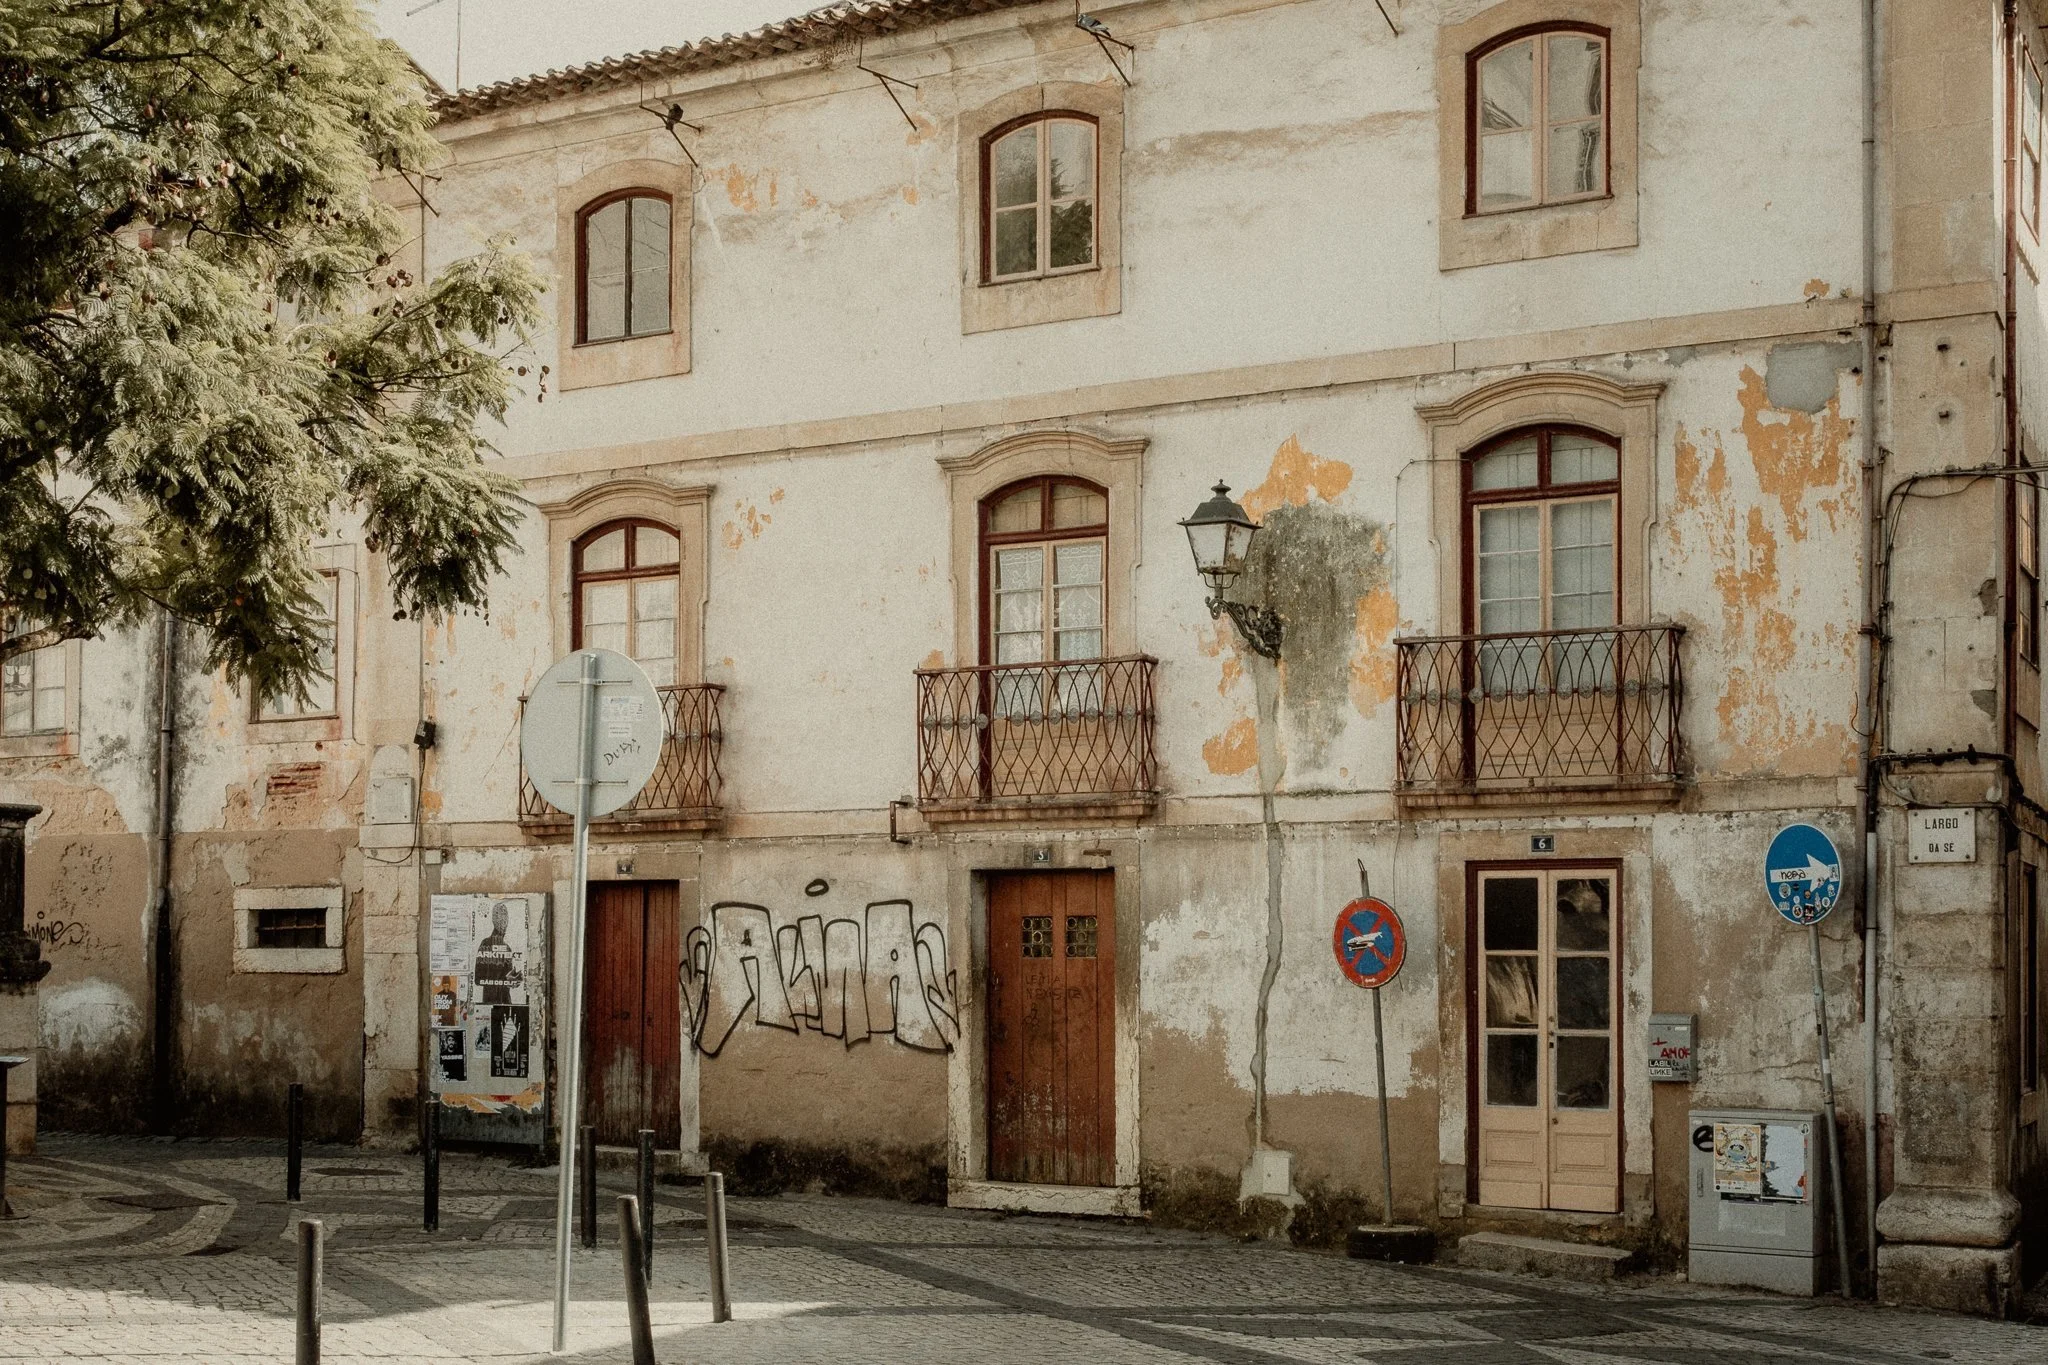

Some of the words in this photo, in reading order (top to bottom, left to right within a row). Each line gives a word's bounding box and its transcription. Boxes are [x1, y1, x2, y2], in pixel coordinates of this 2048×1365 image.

[1924, 817, 1959, 830] LARGO
[1538, 838, 1546, 849] 6
[1038, 850, 1044, 860] 5
